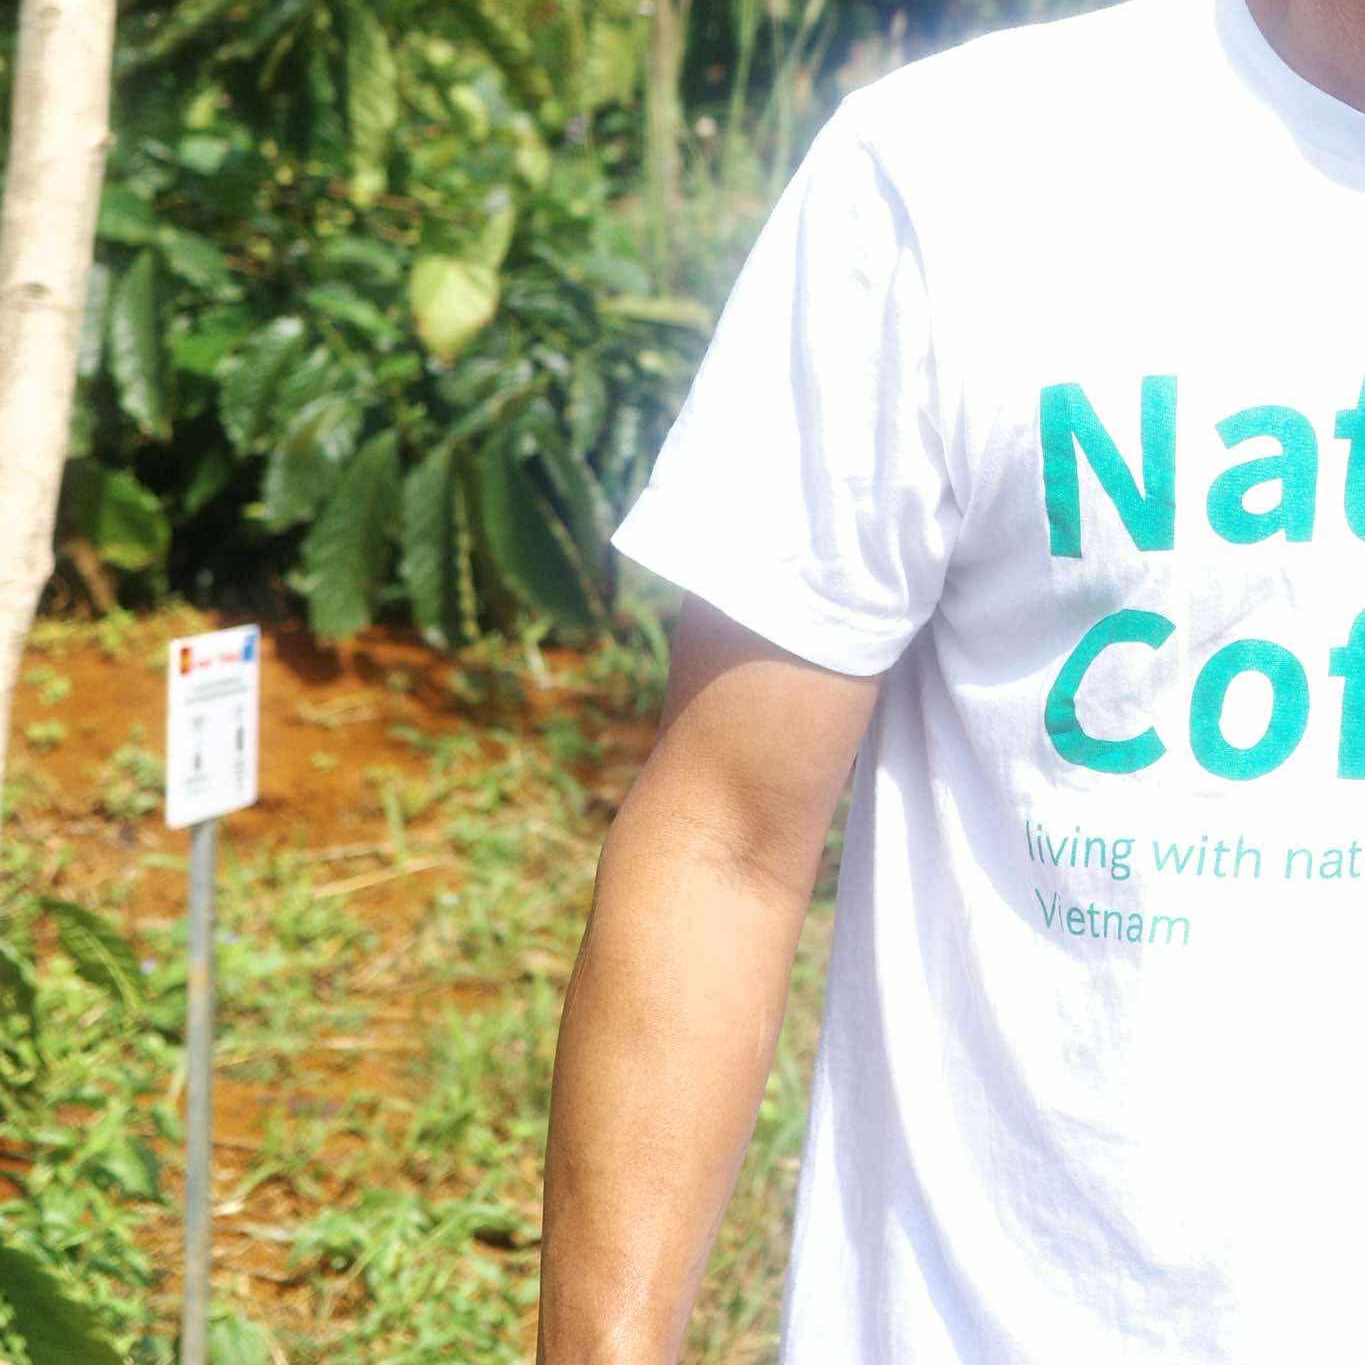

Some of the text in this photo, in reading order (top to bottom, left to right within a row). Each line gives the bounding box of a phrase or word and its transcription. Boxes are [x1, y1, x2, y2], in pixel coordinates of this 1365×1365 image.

[1025, 819, 1136, 881] living
[1151, 835, 1263, 878] with
[1034, 887, 1192, 946] Vietnam
